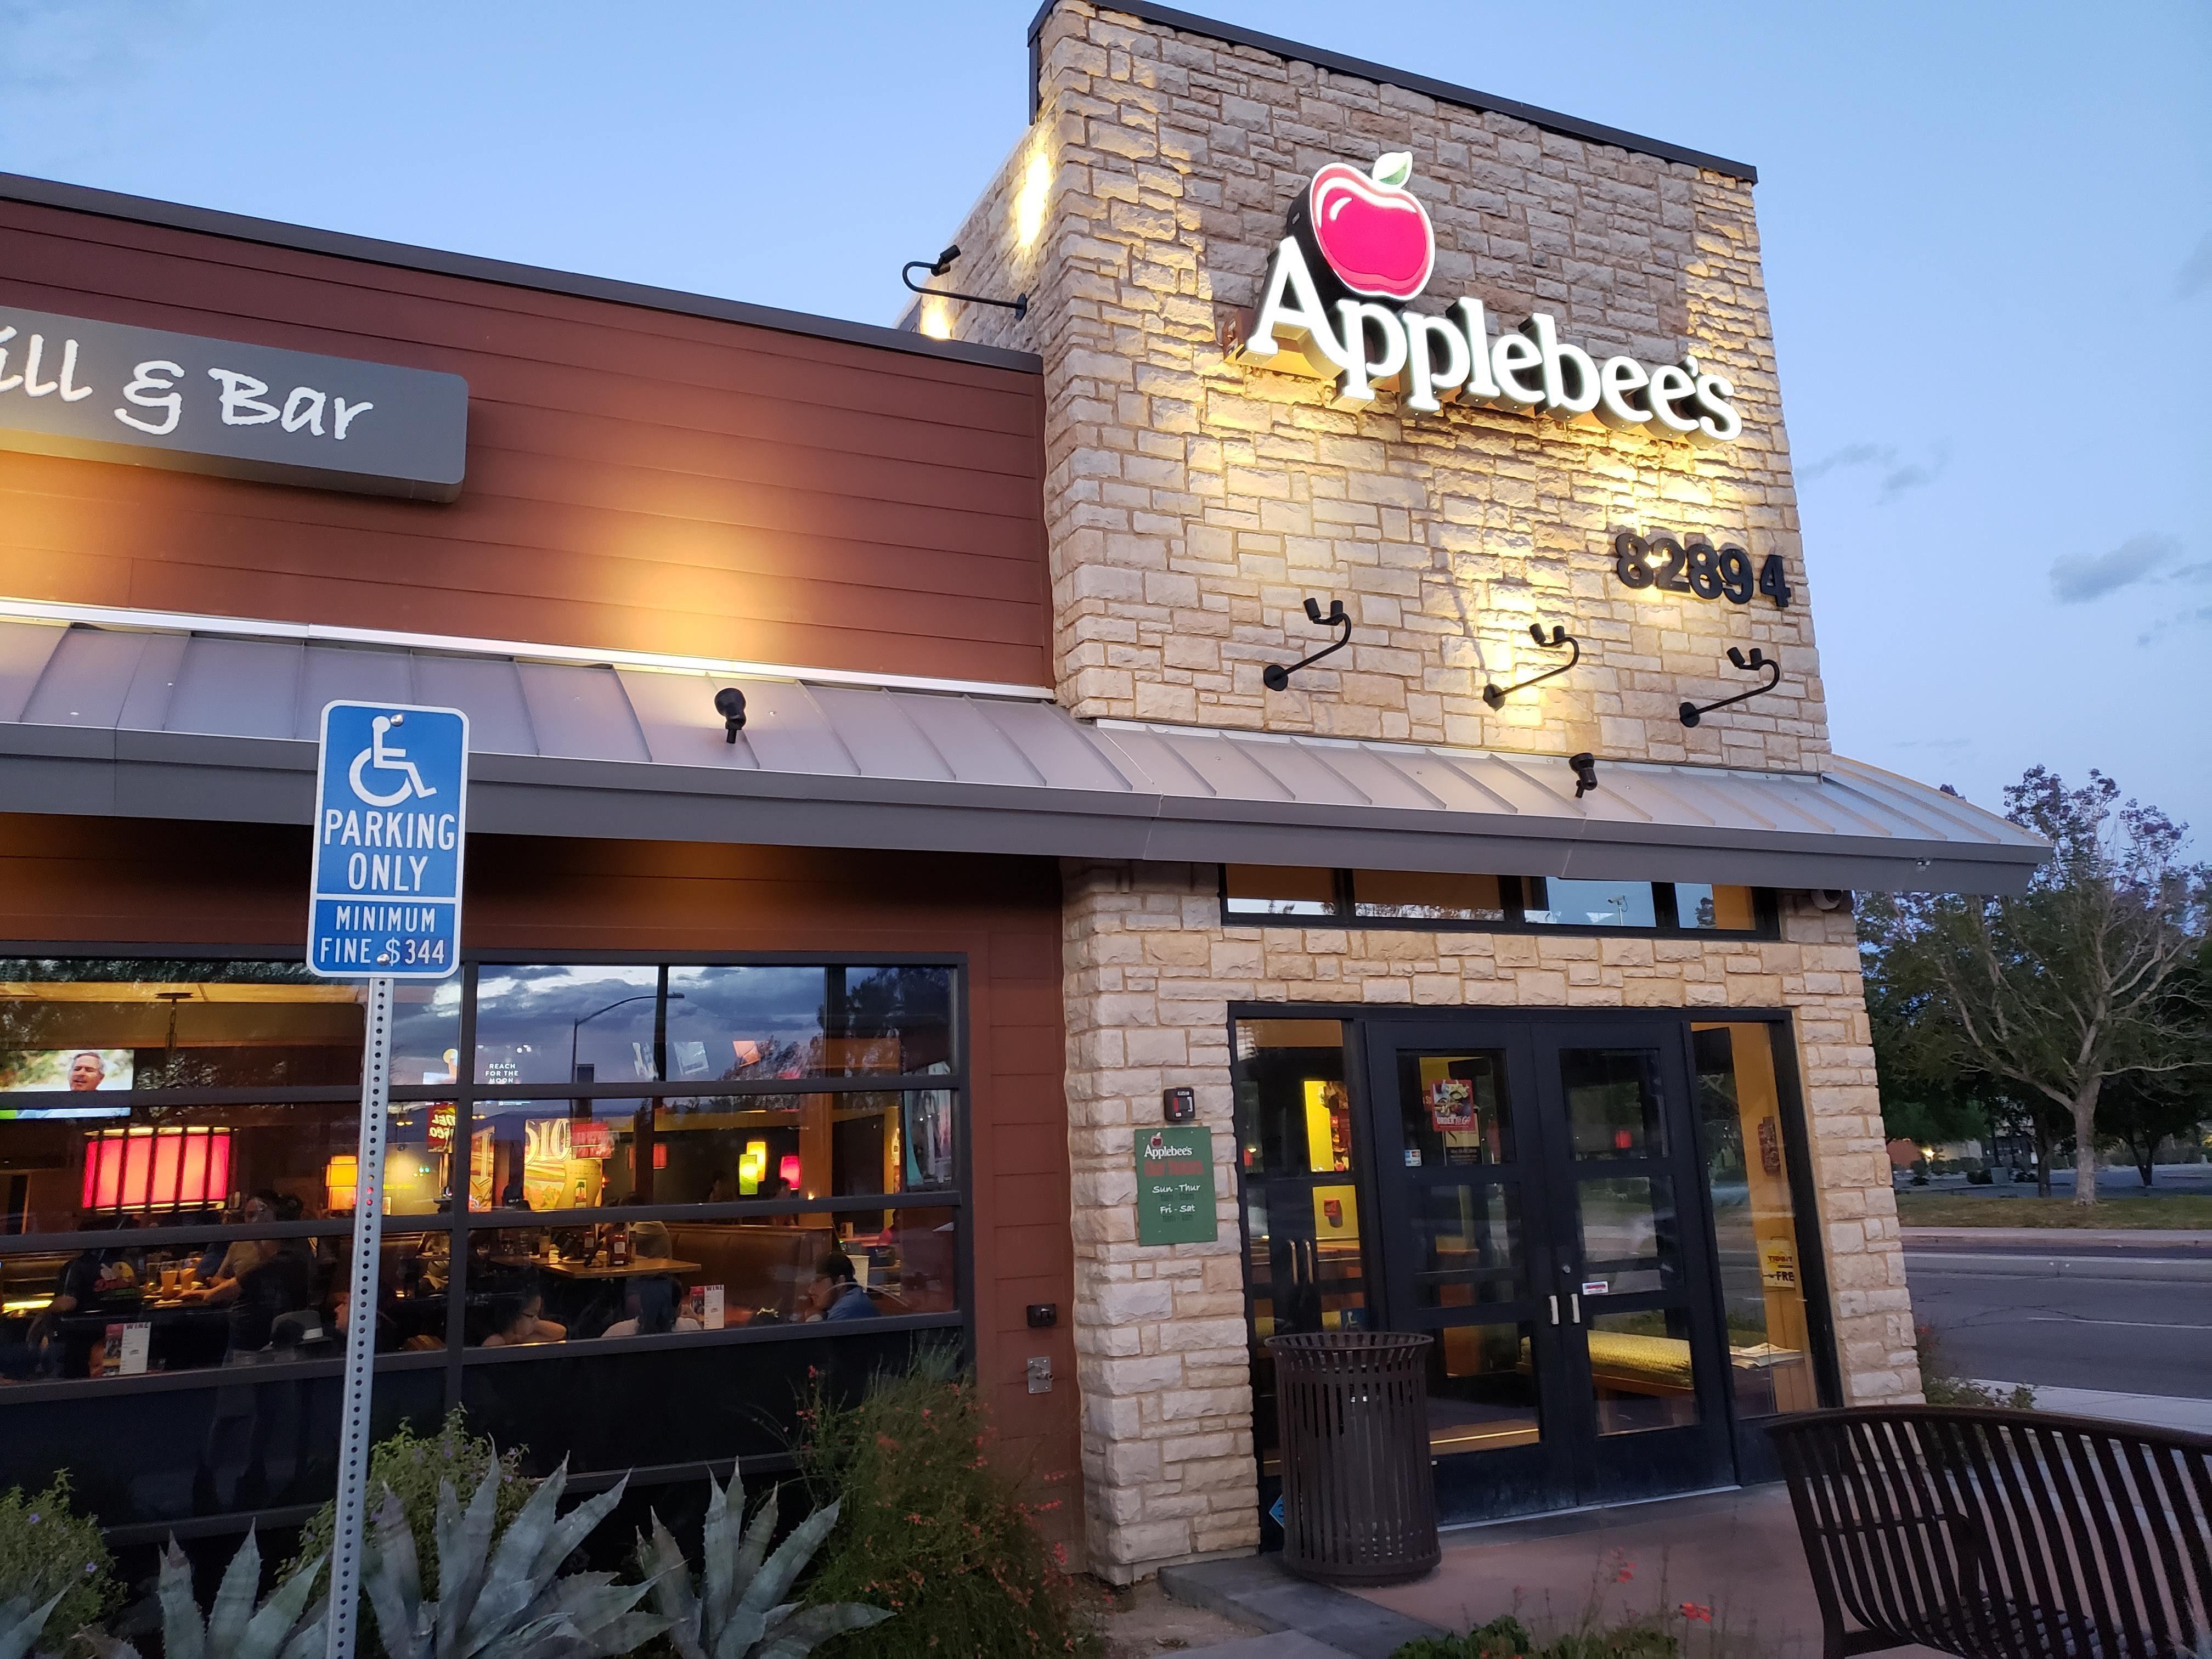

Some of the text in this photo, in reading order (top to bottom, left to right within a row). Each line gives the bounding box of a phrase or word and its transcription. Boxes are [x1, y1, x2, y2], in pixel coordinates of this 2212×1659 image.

[1247, 236, 1742, 442] Applebee's
[114, 359, 185, 436] &
[207, 367, 374, 441] Bar
[1615, 532, 1792, 608] 82894
[324, 809, 455, 850] PARKING
[348, 852, 428, 892] ONLY
[336, 905, 436, 933] MINIMUM
[320, 936, 445, 967] FINE $344
[1144, 1144, 1193, 1159] Applebee's
[1152, 1185, 1173, 1193] Sun
[1178, 1183, 1201, 1192] Thur
[1160, 1204, 1172, 1214] Fri
[1179, 1204, 1195, 1212] Sat
[126, 1322, 149, 1330] WINE
